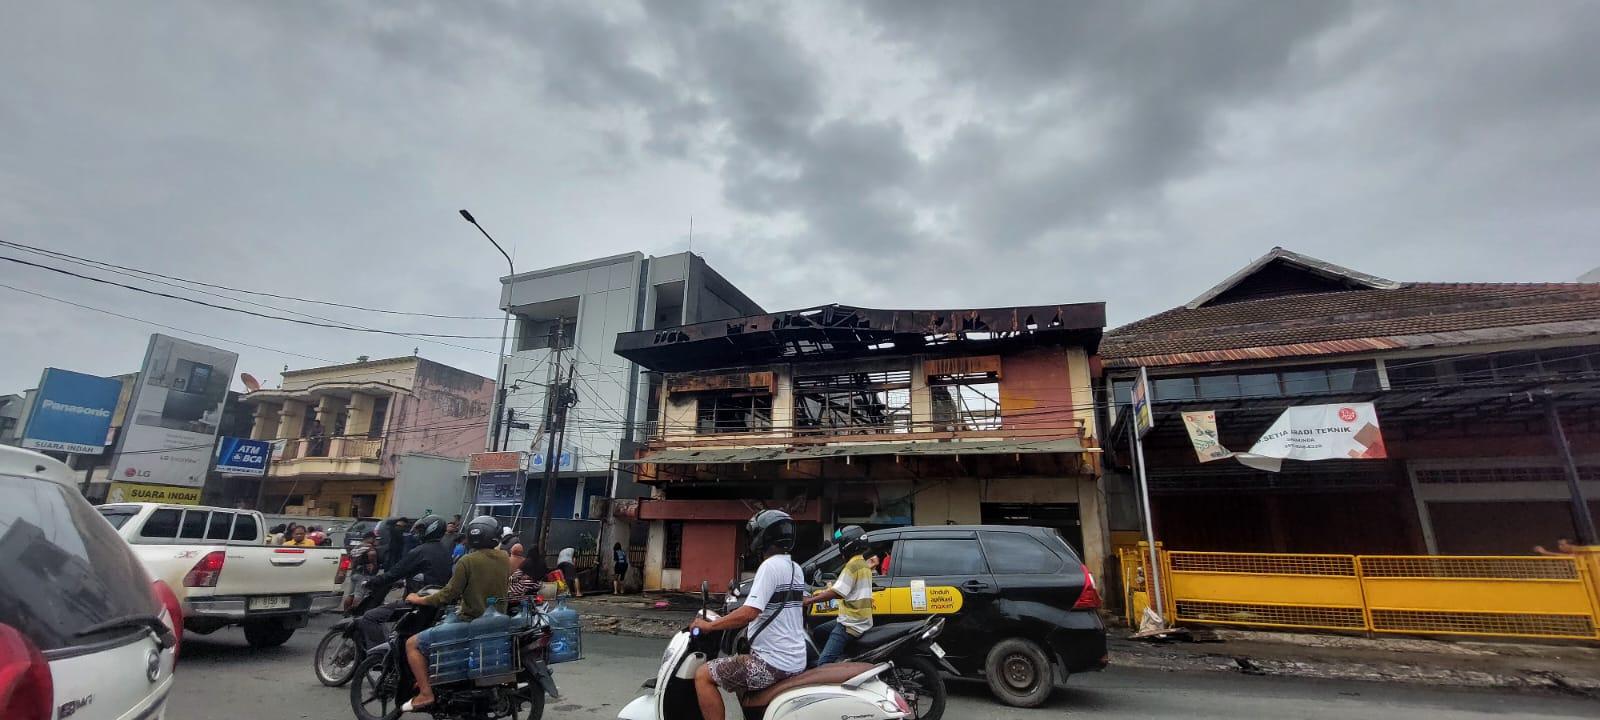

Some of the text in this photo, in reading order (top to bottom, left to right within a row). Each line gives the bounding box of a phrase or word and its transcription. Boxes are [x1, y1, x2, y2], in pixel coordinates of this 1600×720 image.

[42, 399, 111, 418] Panasonic
[1314, 426, 1351, 434] TEKNIK
[35, 440, 94, 453] SUARA INDAH
[237, 445, 261, 455] ATM
[242, 454, 262, 464] BCA
[136, 470, 151, 478] LG
[131, 488, 198, 501] SUARA INDAH
